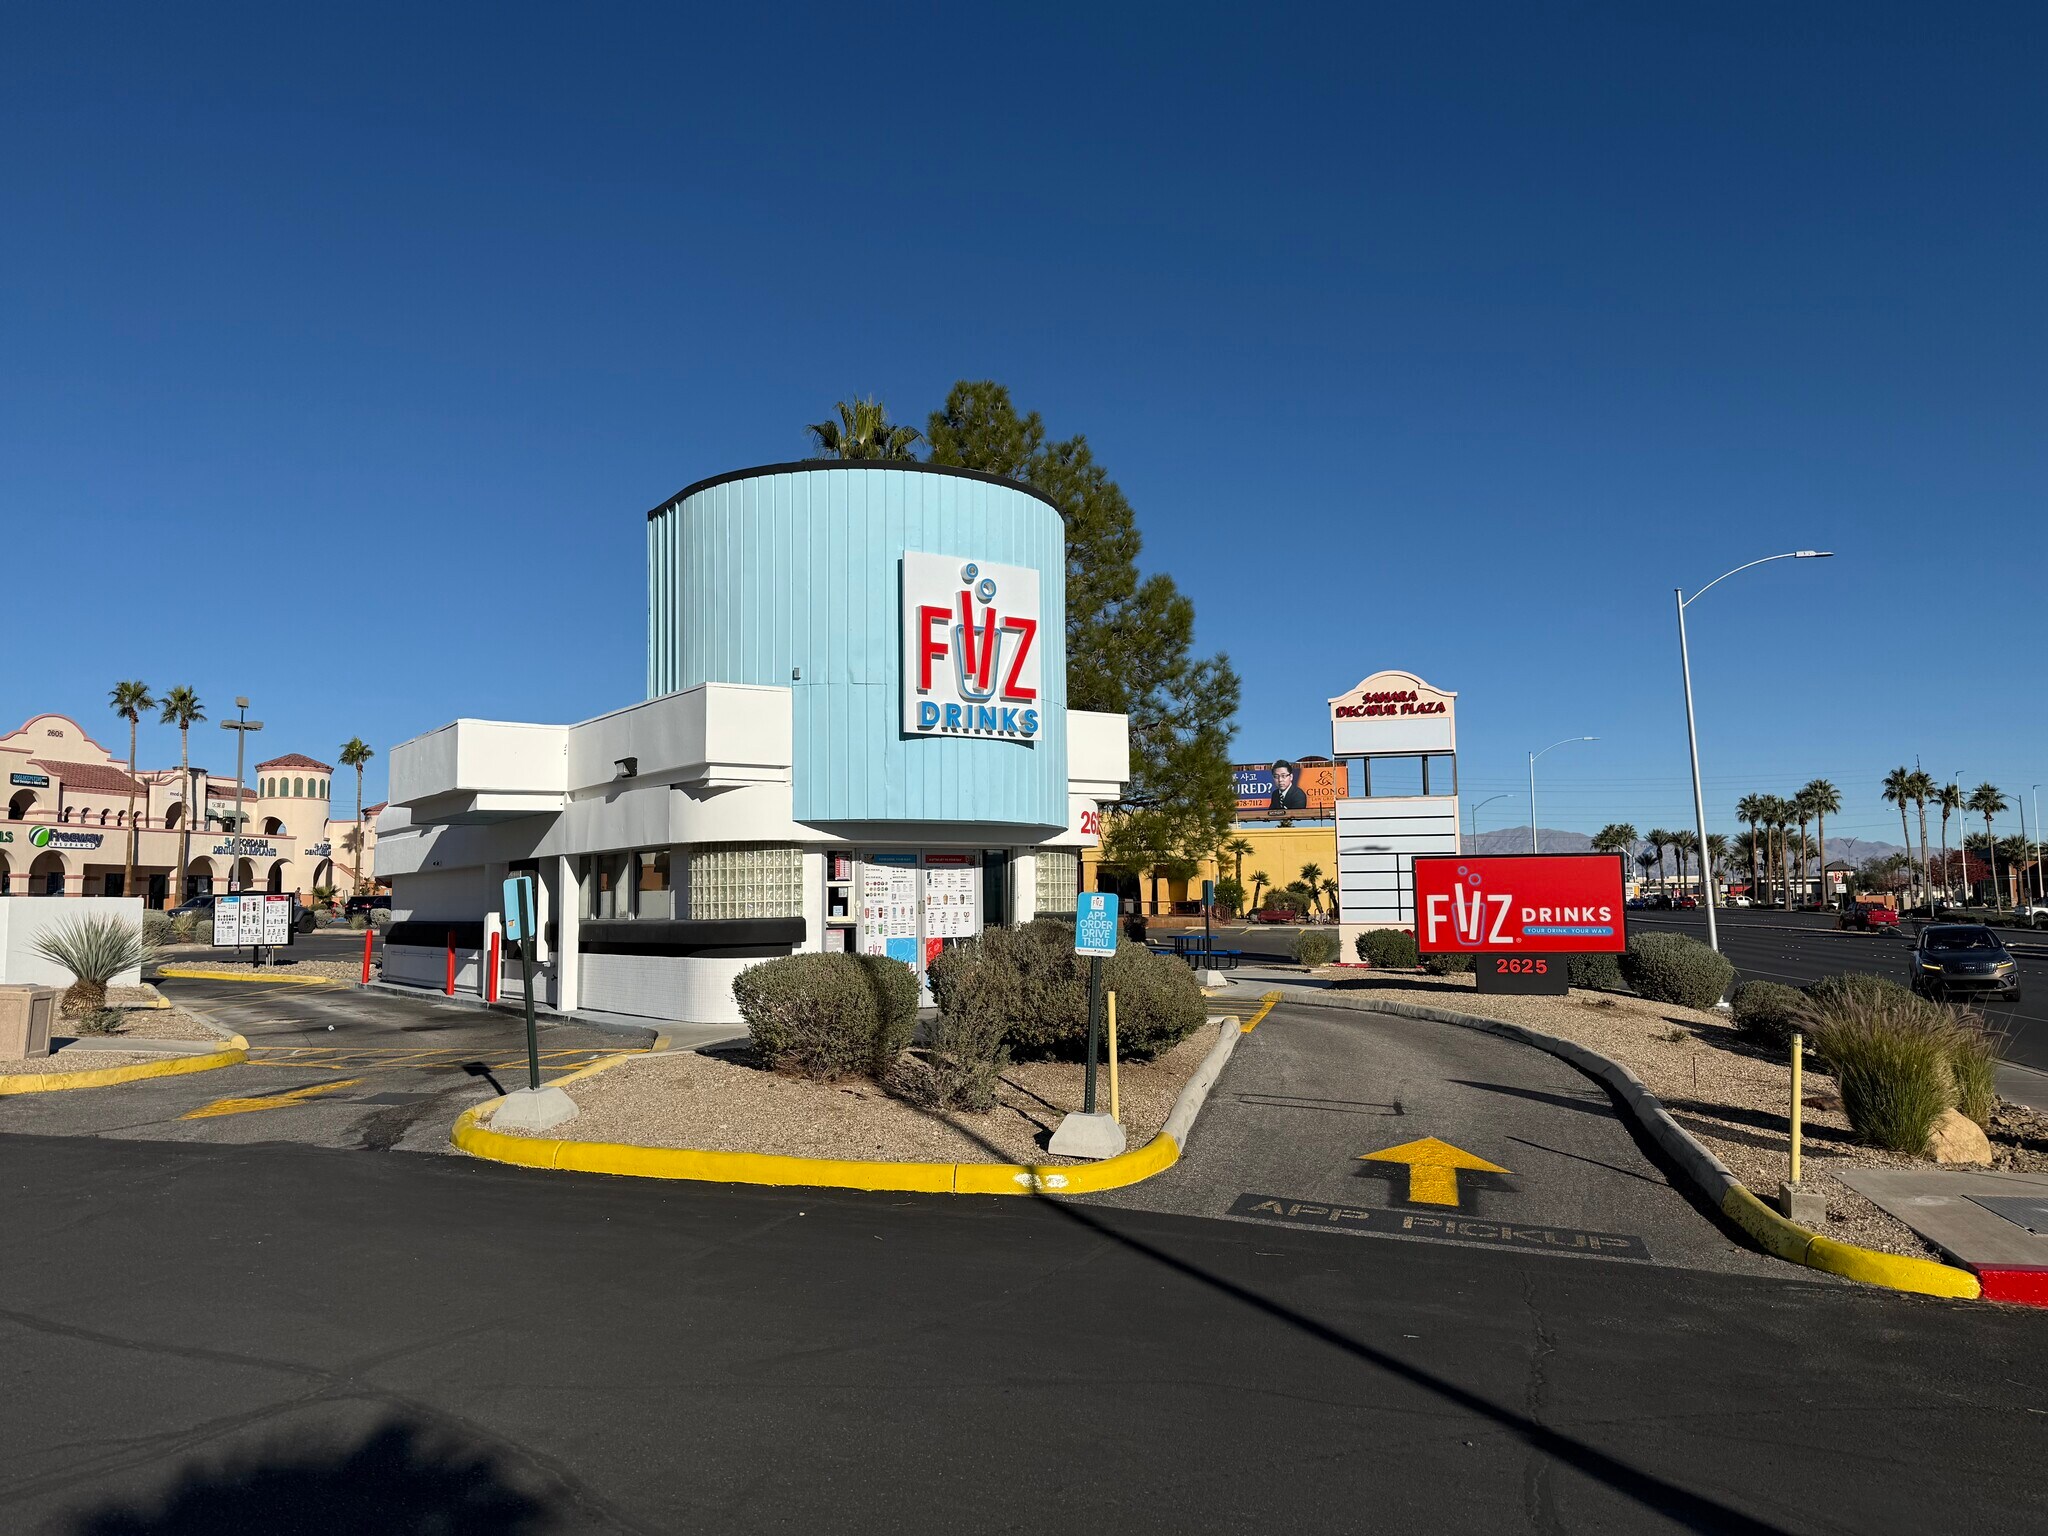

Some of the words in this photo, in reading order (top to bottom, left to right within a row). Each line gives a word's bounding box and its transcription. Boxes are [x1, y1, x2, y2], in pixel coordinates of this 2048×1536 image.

[1361, 690, 1419, 704] SAHARA
[917, 700, 1039, 734] DRINKS
[1336, 703, 1398, 718] DECATUR
[1400, 702, 1446, 716] PLAZA
[47, 729, 64, 738] 2605
[48, 828, 104, 848] Freeway
[1087, 911, 1107, 920] APP
[1521, 906, 1612, 922] DRINKS
[1080, 920, 1113, 929] ORDER
[1082, 929, 1110, 938] DRIVE
[1082, 937, 1109, 947] THRU
[1496, 958, 1548, 974] 2625
[1251, 1200, 1370, 1221] APP
[1401, 1215, 1631, 1249] PICKUP
